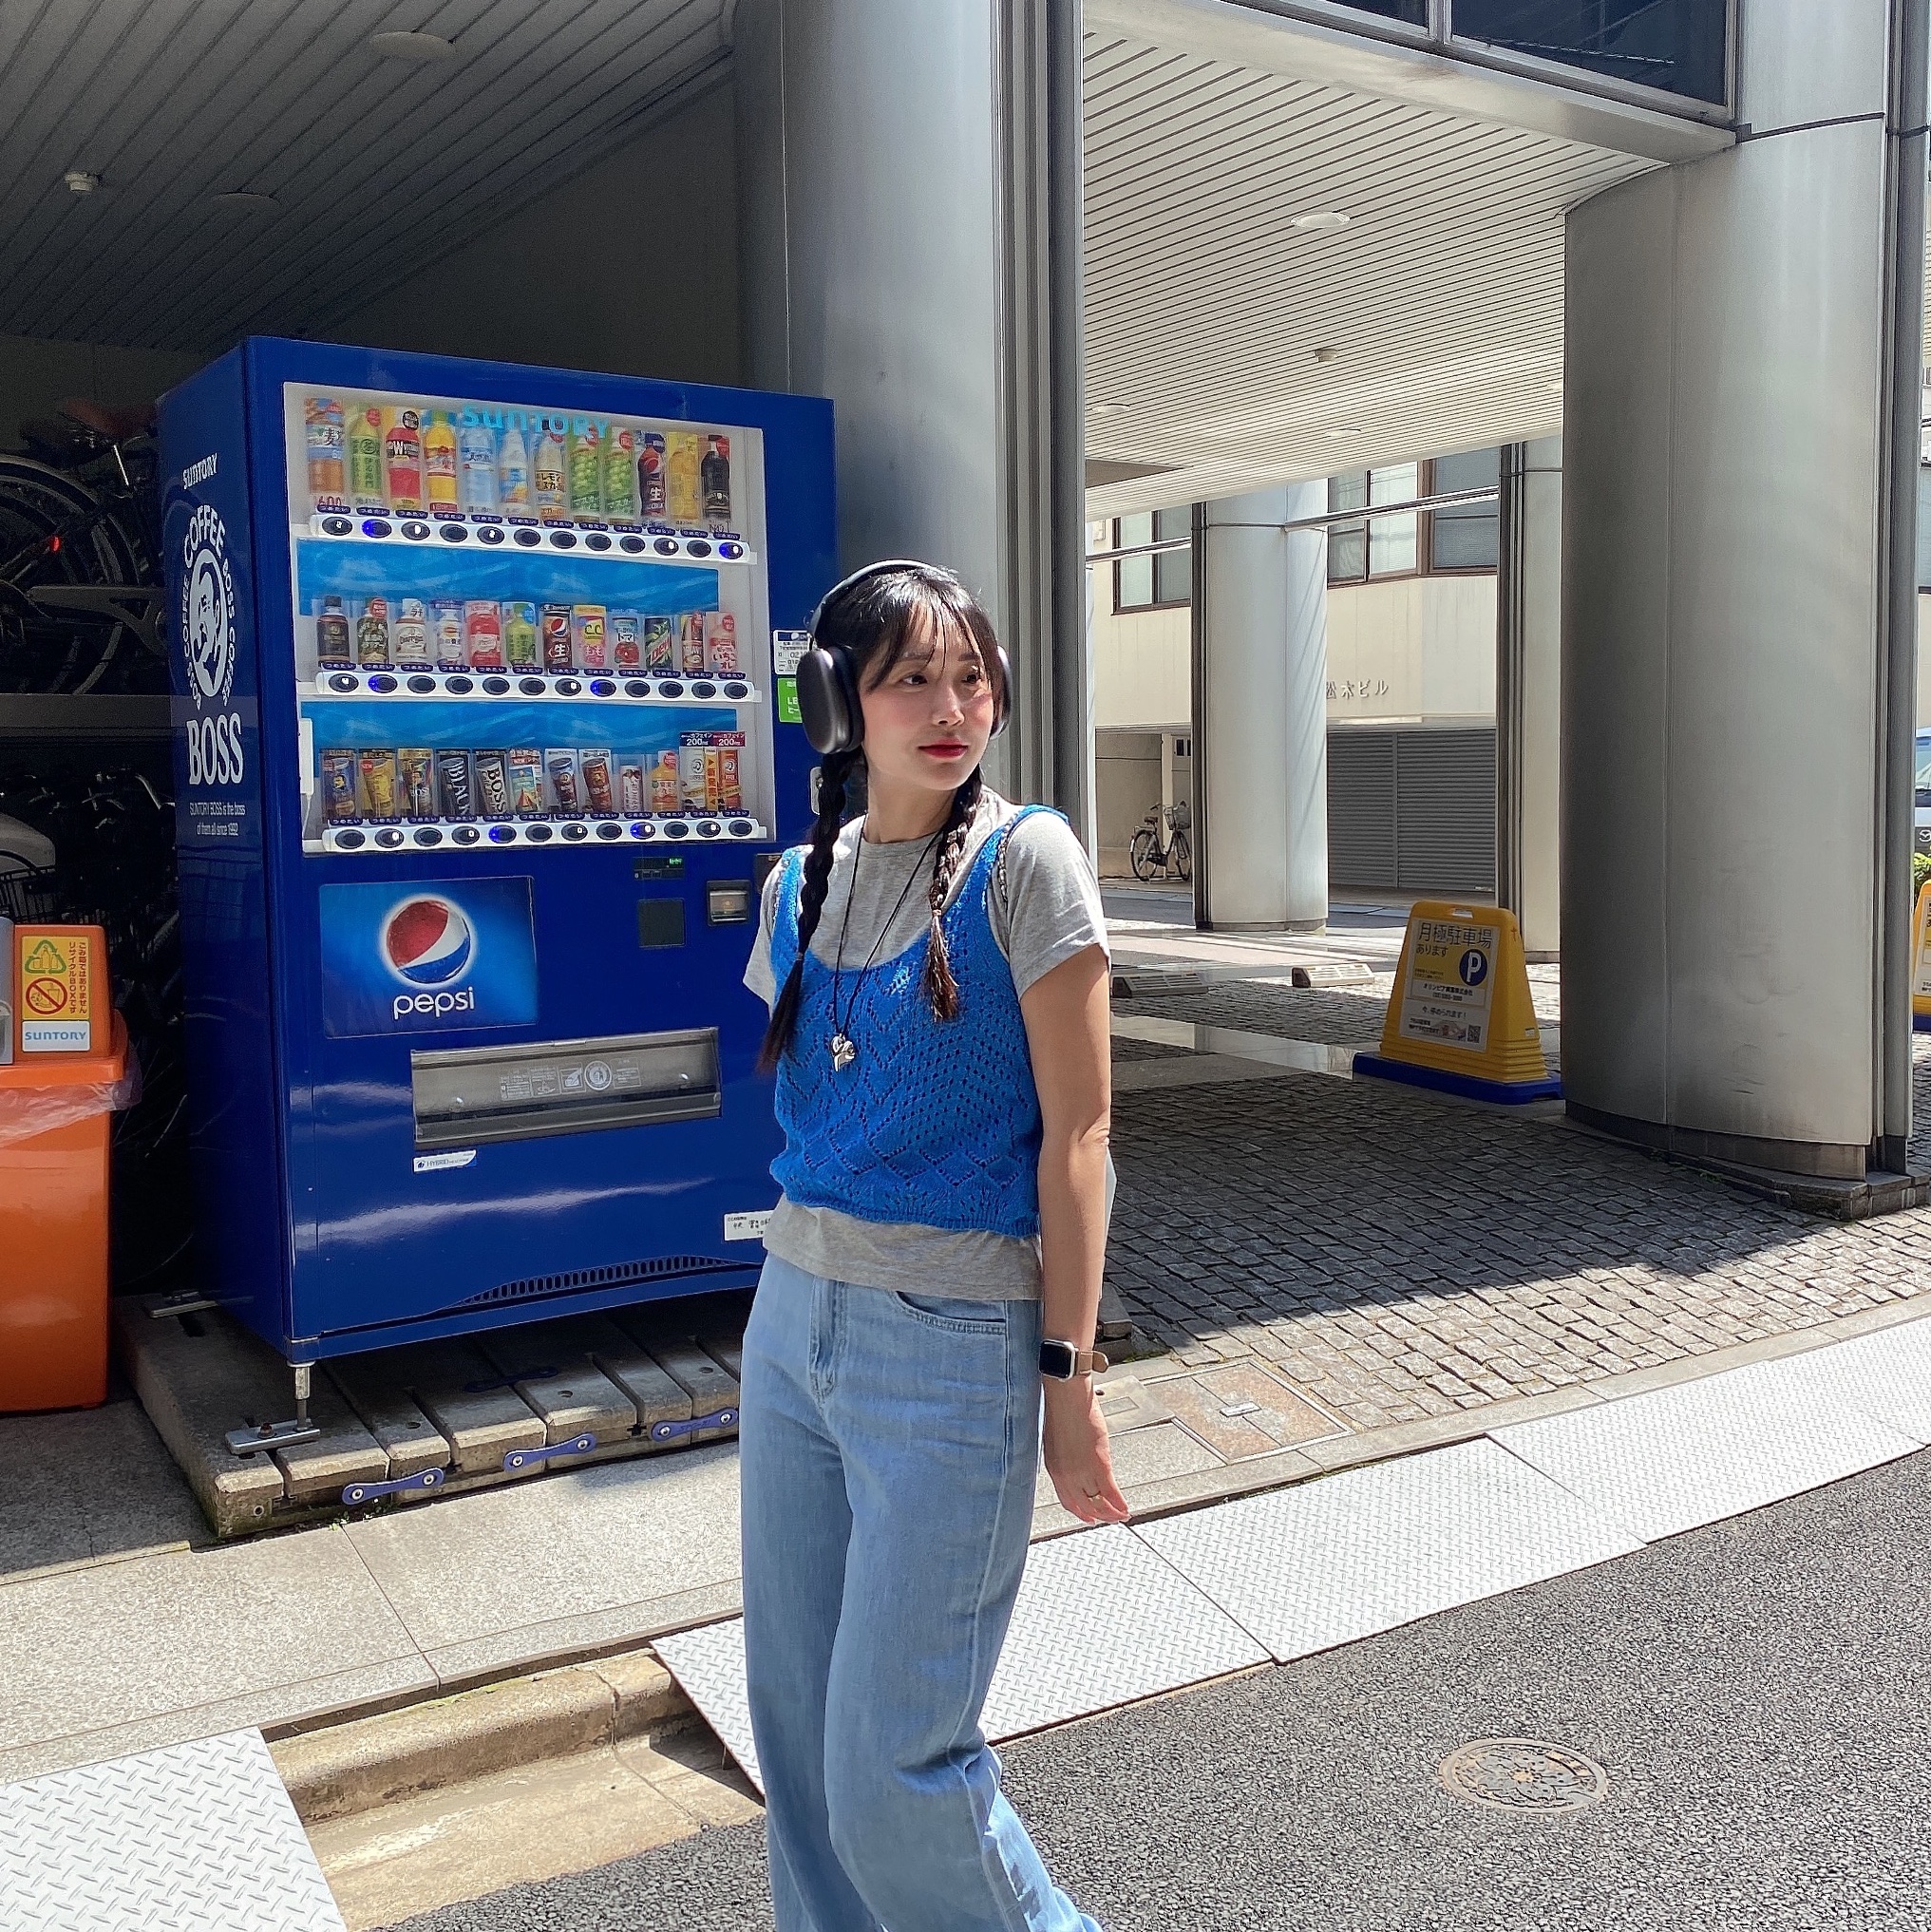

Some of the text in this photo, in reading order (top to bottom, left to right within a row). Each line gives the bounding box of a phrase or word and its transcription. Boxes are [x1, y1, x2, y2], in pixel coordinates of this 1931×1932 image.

[183, 452, 218, 490] SUNTORY
[184, 505, 226, 568] COFFEE
[186, 712, 243, 785] BOSS
[487, 767, 506, 812] BOSS
[1416, 943, 1448, 957] あります
[1418, 921, 1493, 949] 月極駐車場
[1467, 952, 1482, 982] P
[393, 986, 475, 1019] pepsi
[25, 1031, 86, 1040] SUNTORY
